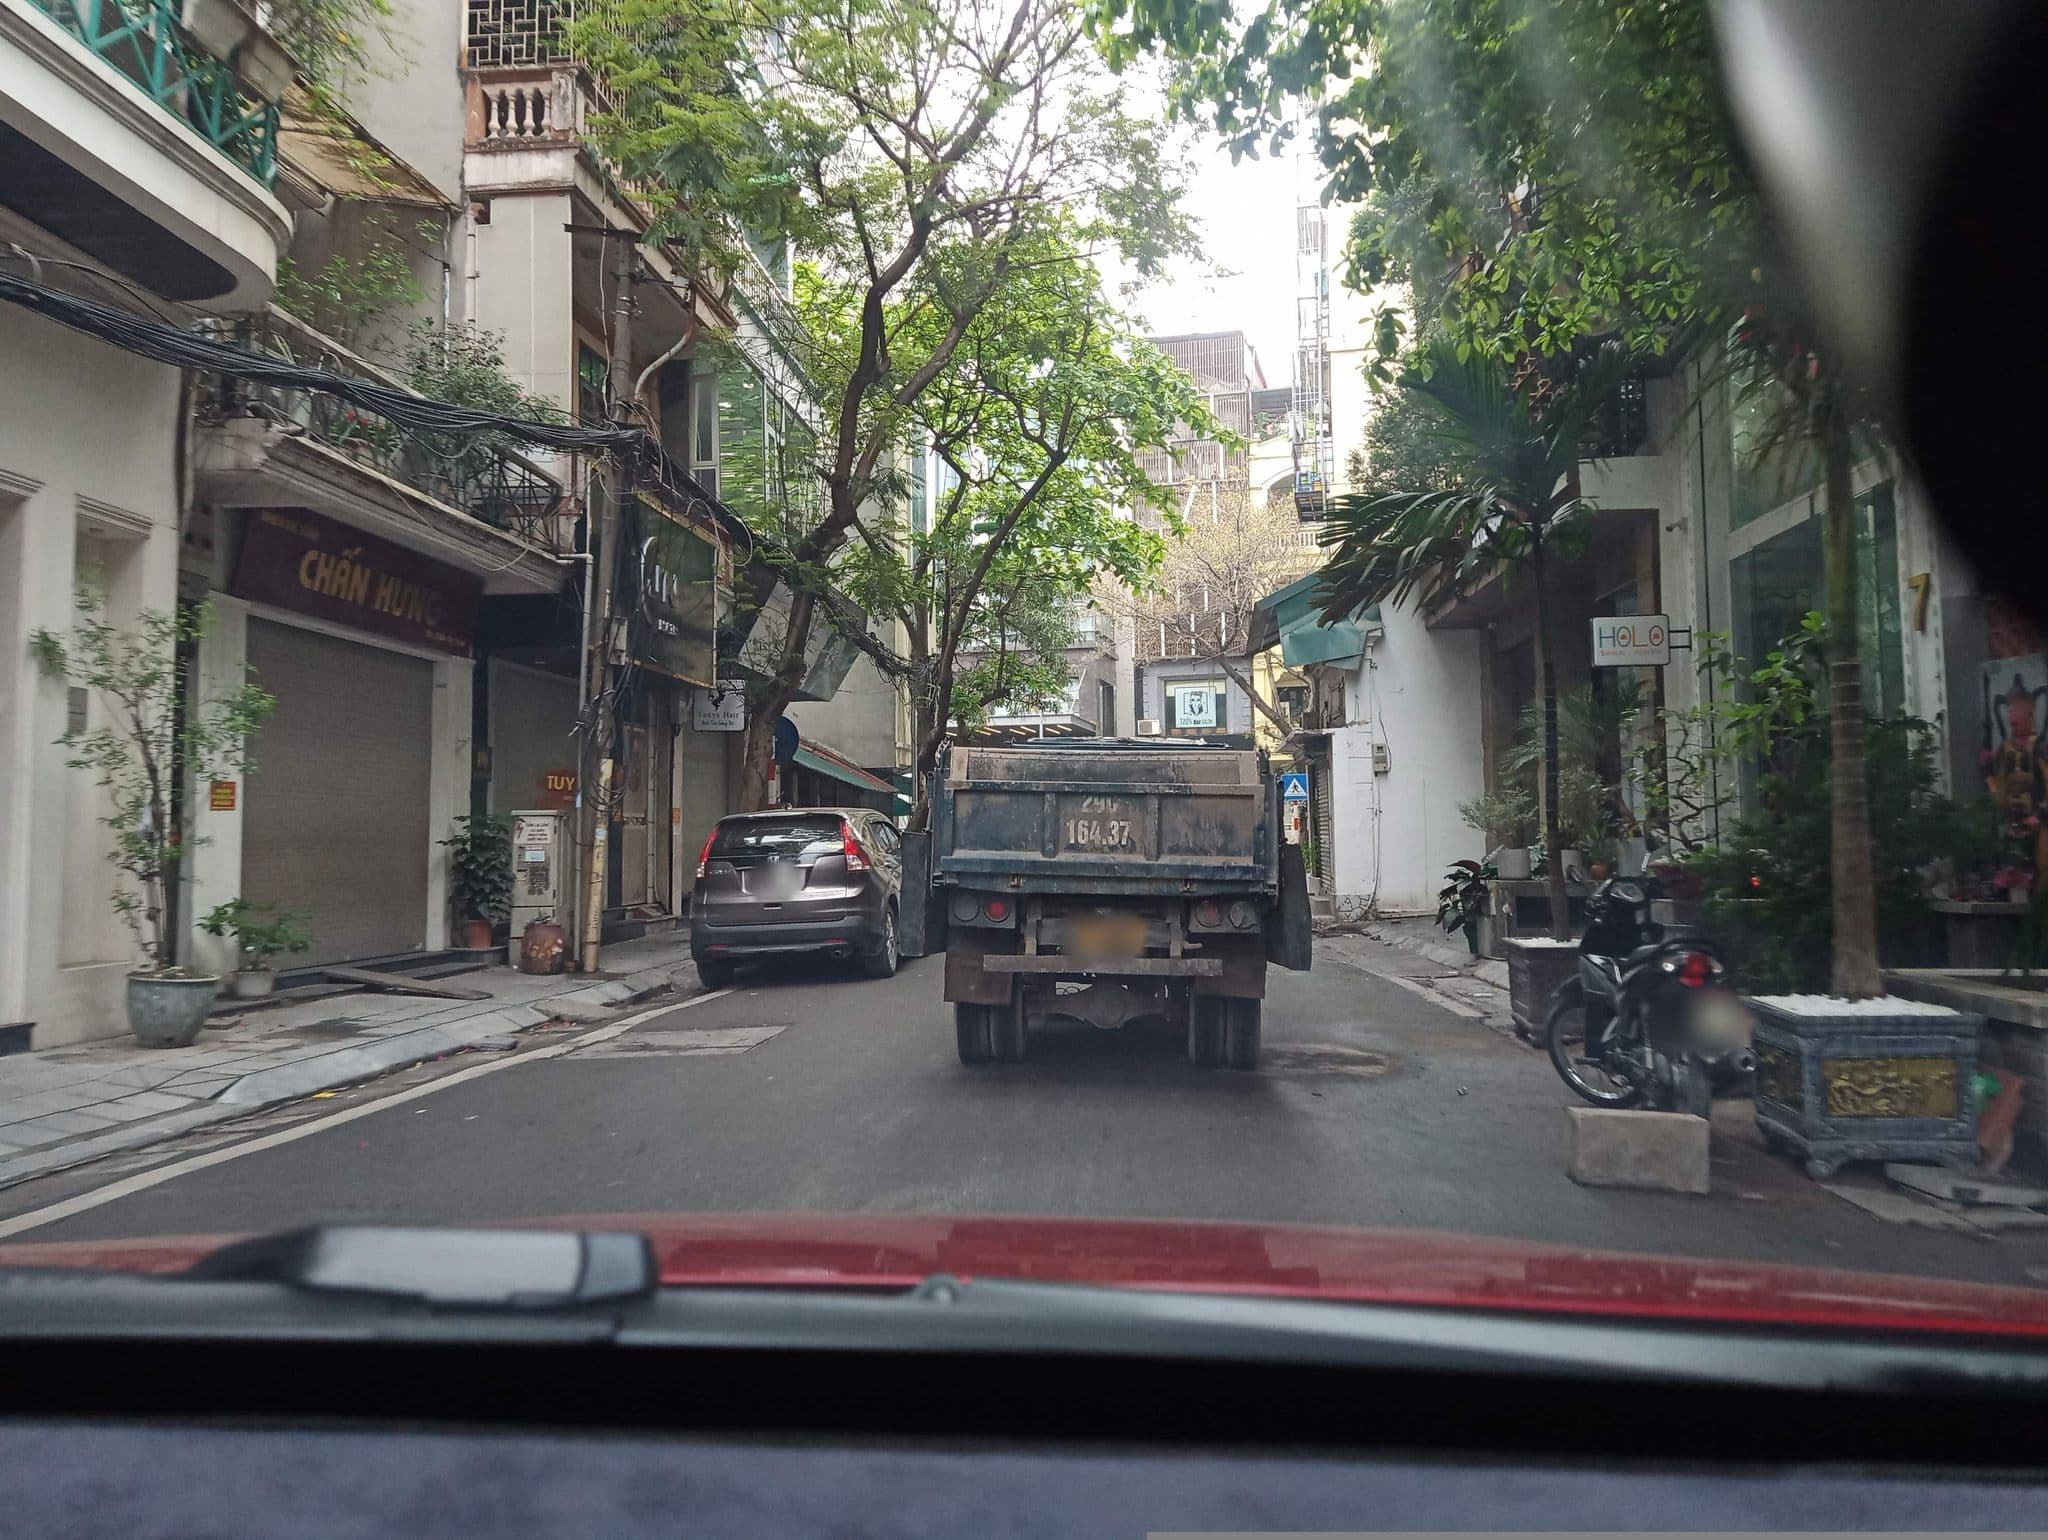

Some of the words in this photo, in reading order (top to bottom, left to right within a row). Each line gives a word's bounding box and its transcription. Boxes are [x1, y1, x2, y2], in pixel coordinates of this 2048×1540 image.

[299, 547, 371, 605] CHẤN
[1907, 573, 1930, 632] 7
[1599, 625, 1664, 648] HOLO
[1066, 819, 1132, 846] 164.37
